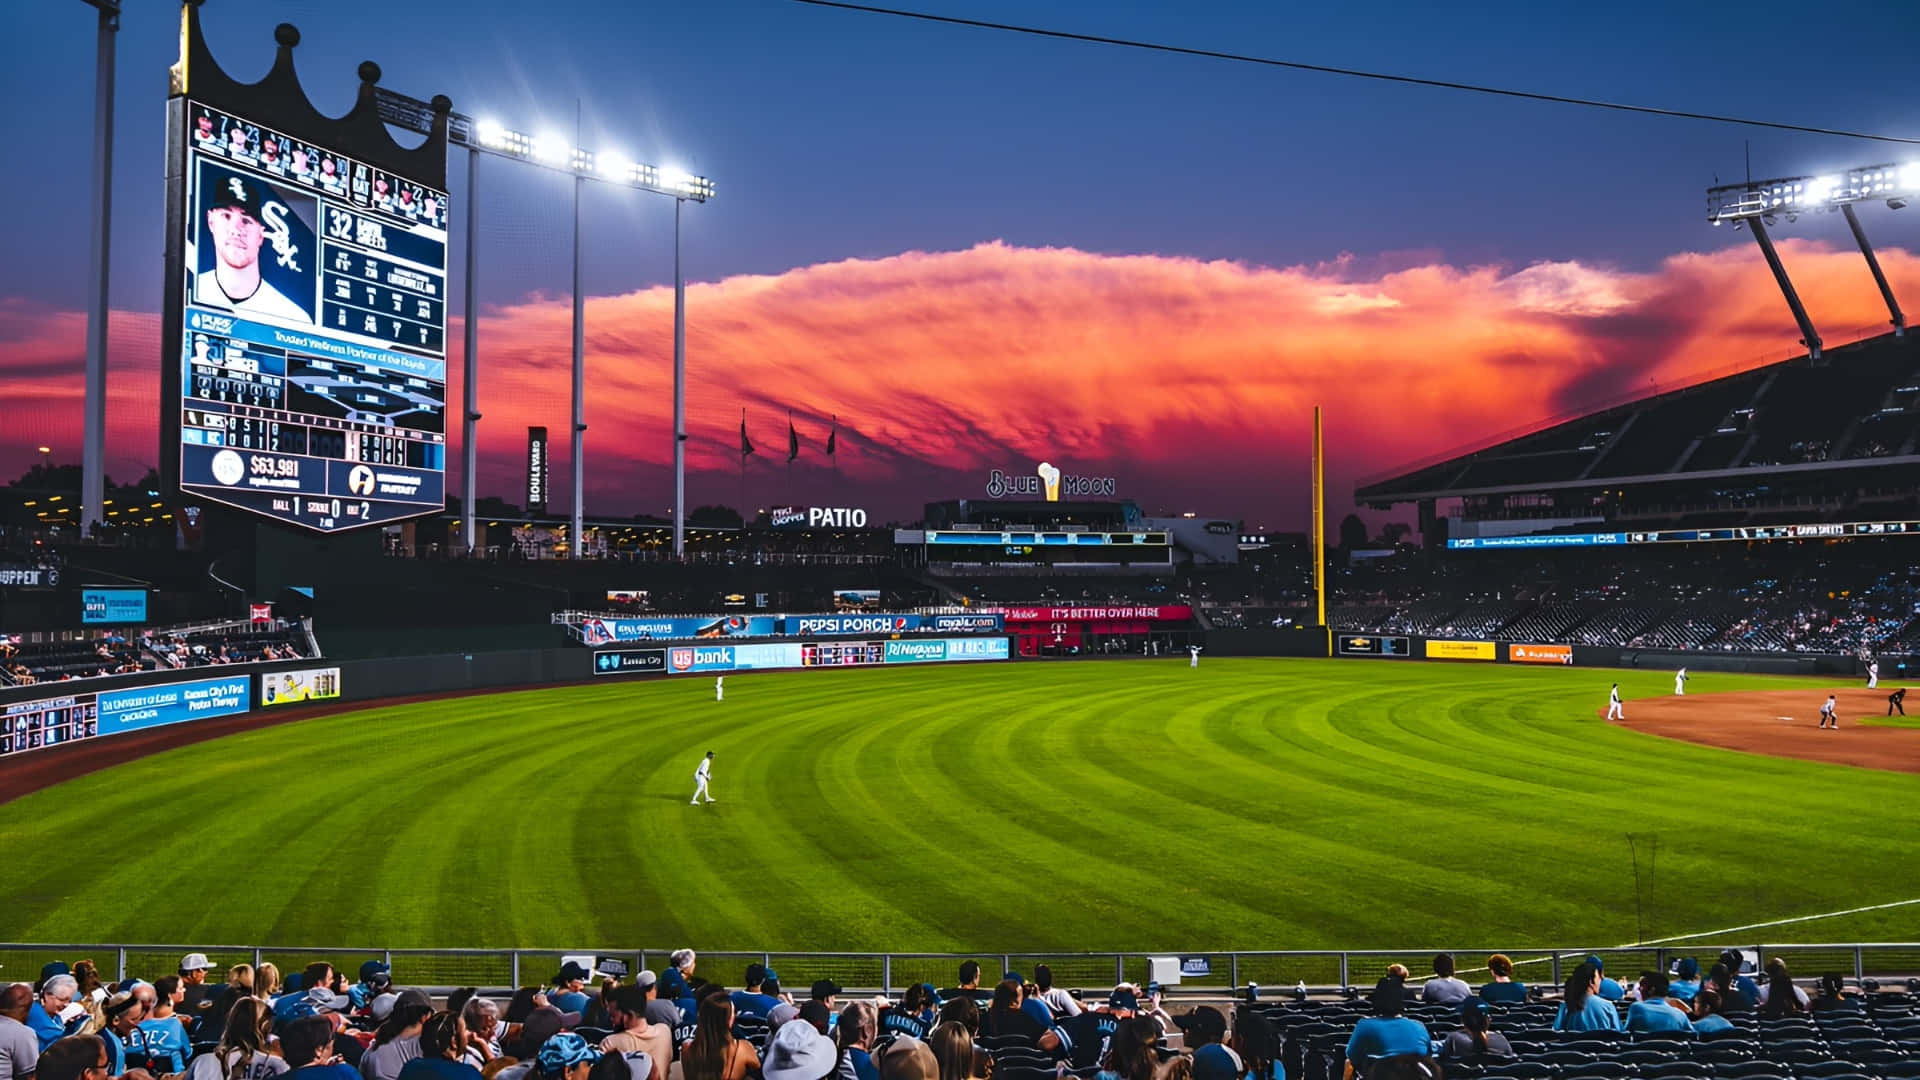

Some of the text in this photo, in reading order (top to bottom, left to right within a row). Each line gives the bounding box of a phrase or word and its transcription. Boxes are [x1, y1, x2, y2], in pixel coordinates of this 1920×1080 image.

[245, 125, 259, 142] 23
[329, 209, 353, 241] 32
[529, 440, 541, 503] BOULEVARD
[293, 496, 300, 516] 1
[331, 499, 340, 518] 0
[361, 502, 370, 520] 2
[809, 507, 867, 528] PATIO
[1071, 607, 1106, 618] BETTER
[1108, 607, 1132, 618] OVER
[1135, 606, 1159, 617] HERE
[799, 618, 892, 632] PEPSI PORCH
[694, 647, 731, 664] bank
